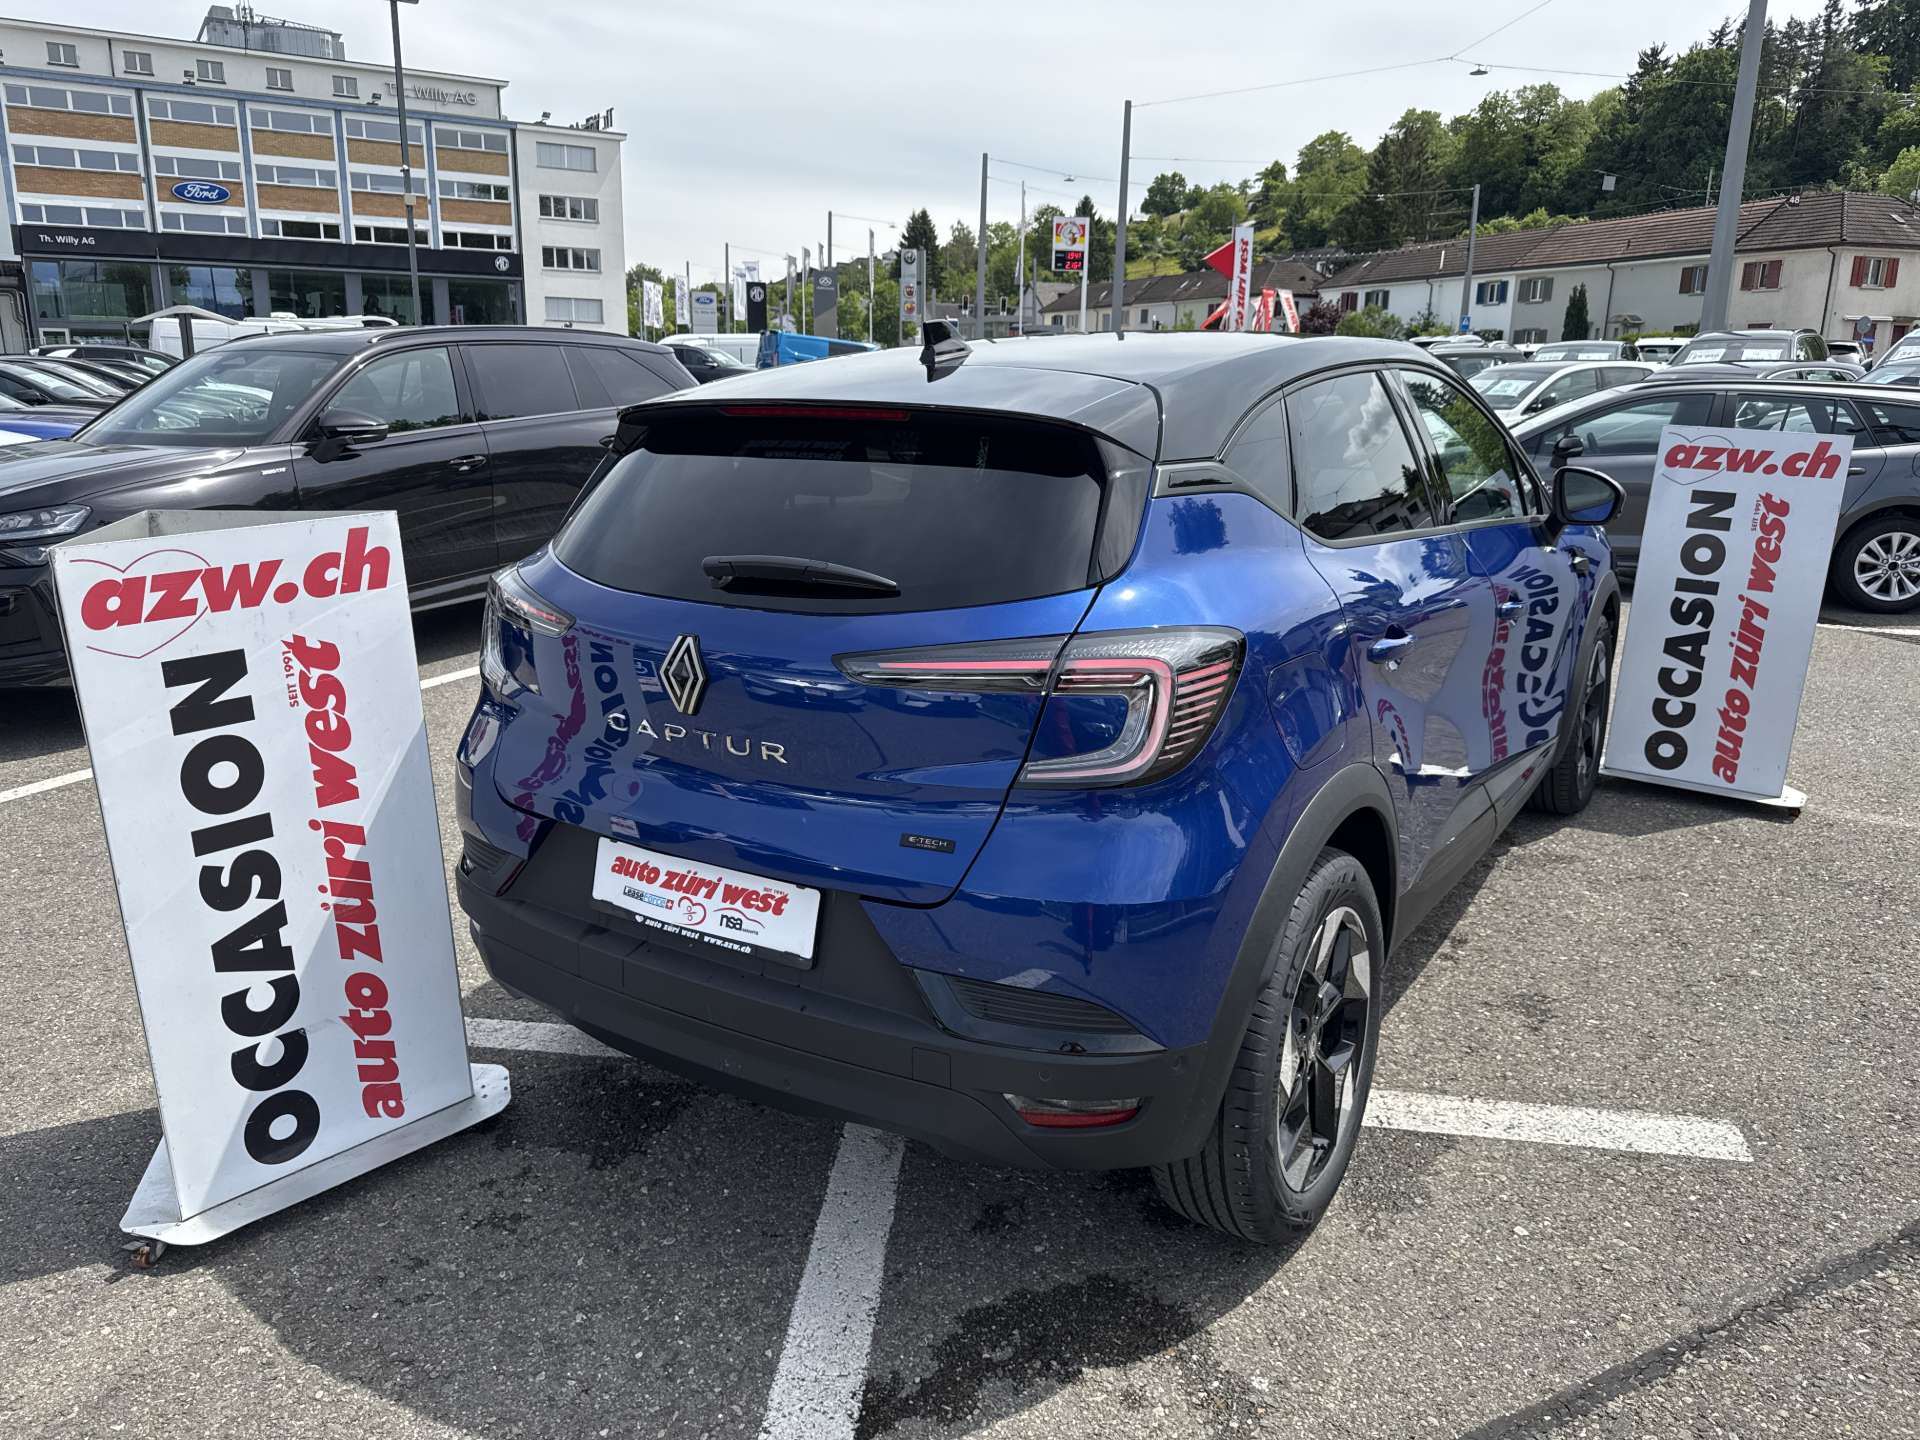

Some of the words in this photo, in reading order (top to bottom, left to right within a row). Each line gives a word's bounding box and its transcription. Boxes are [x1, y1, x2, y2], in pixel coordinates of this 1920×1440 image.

[414, 83, 449, 105] Willy
[455, 88, 477, 105] AG
[1790, 196, 1800, 204] 48
[39, 234, 53, 244] Th.
[56, 235, 79, 246] Willy
[81, 236, 96, 246] AG
[1239, 238, 1250, 275] west
[751, 287, 764, 302] MG
[1664, 441, 1842, 480] azw.ch
[1751, 514, 1760, 531] SEIT
[1752, 499, 1762, 514] 1991
[1747, 492, 1791, 594] west
[81, 526, 391, 631] azw.ch
[1644, 489, 1737, 771] OCCASION
[1728, 594, 1770, 690] züri
[282, 650, 296, 678] 1991
[287, 682, 300, 708] SEIT
[281, 632, 361, 810] west
[607, 712, 790, 765] CAPTUR
[1711, 688, 1751, 784] auto
[908, 835, 948, 848] E-TECH
[309, 818, 384, 964] züri
[610, 855, 661, 885] auto
[659, 869, 723, 901] züri
[720, 883, 790, 916] west
[161, 648, 321, 1166] OCCASION
[719, 913, 743, 931] nsa
[645, 919, 662, 930] auto
[681, 928, 700, 940] west
[703, 935, 752, 954] www.azw.ch
[338, 969, 405, 1120] auto
